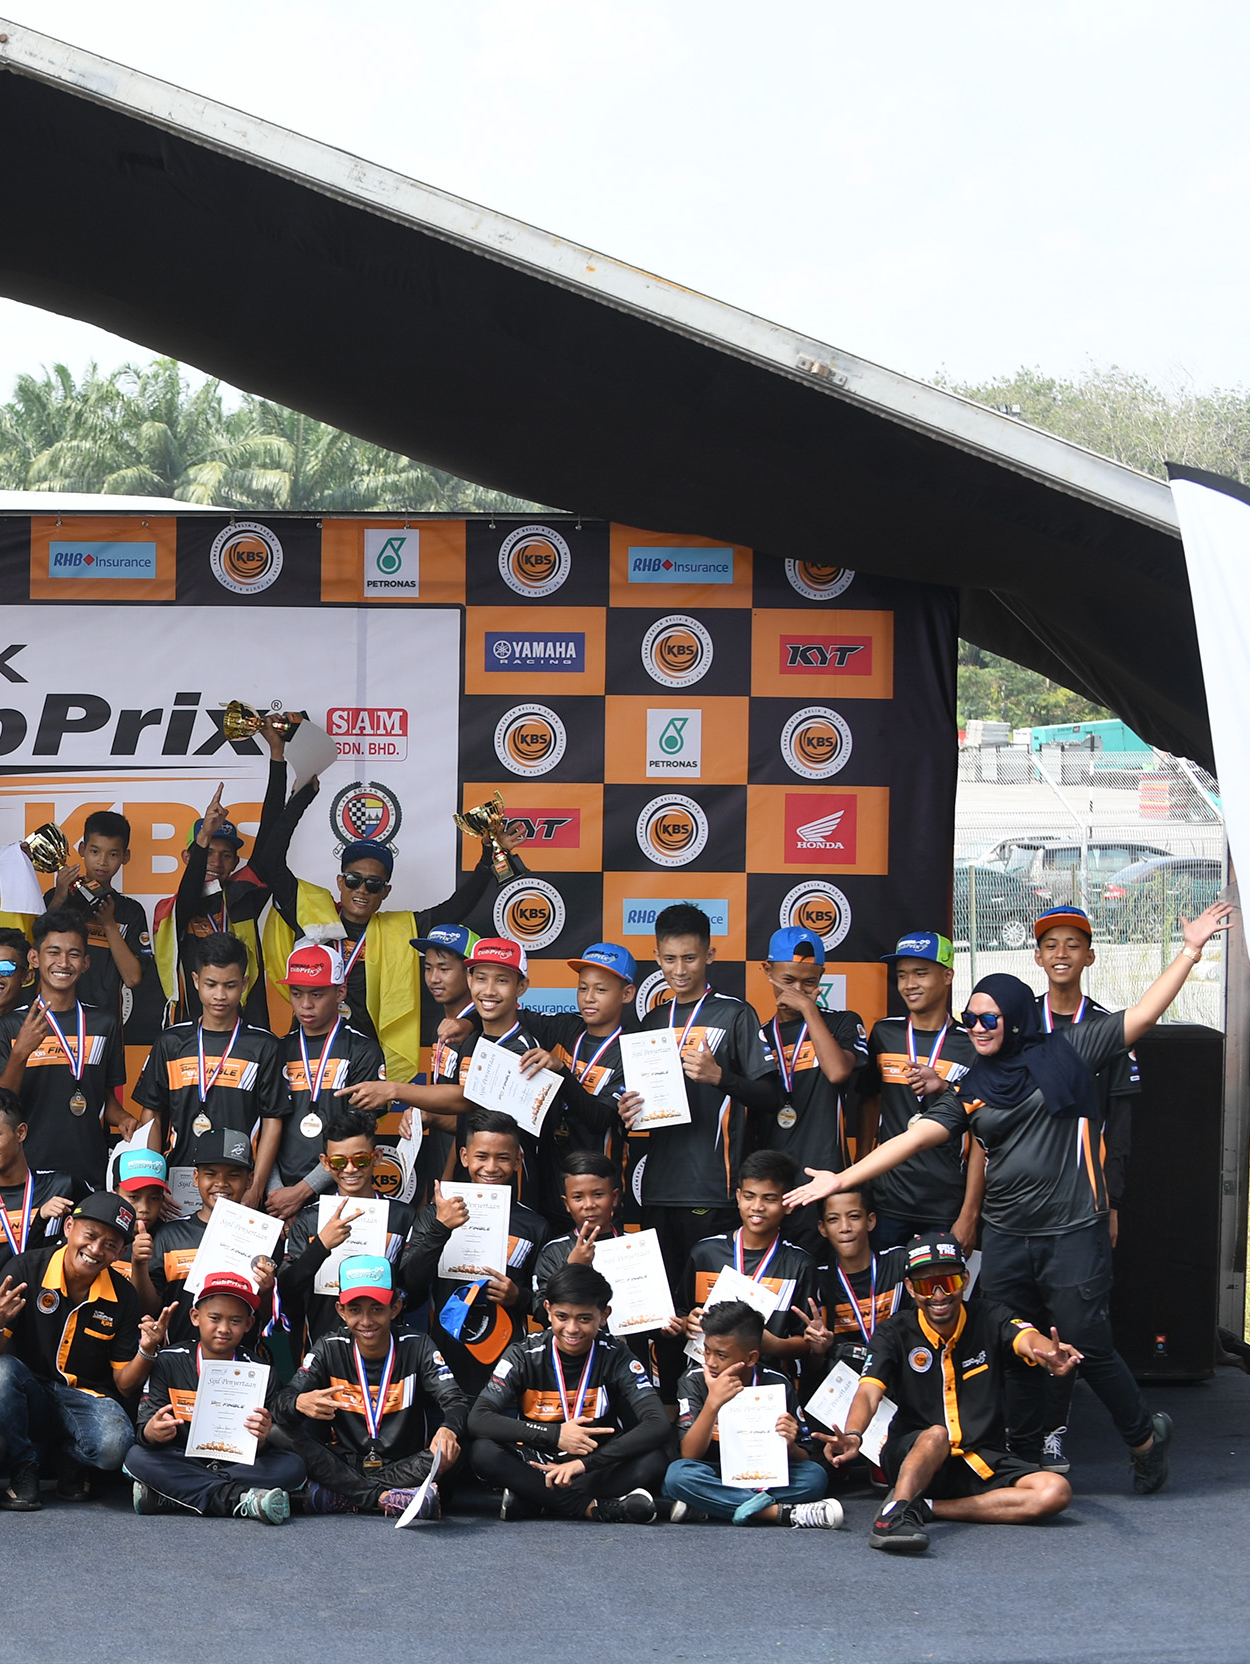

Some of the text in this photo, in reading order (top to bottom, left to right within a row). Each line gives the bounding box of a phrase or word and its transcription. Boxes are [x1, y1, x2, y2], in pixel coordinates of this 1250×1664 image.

[53, 552, 151, 568] RHB Insurance
[236, 551, 263, 563] KBS
[524, 555, 551, 567] KBS
[632, 557, 729, 573] RHB Insurance
[366, 580, 416, 588] PETRONAS
[512, 641, 576, 659] YAMAHA
[667, 645, 694, 657] KBS
[786, 645, 865, 667] KYT
[332, 711, 403, 734] SAM
[520, 734, 547, 746] KBS
[806, 737, 833, 749] KBS
[368, 742, 400, 755] BHD.
[649, 760, 698, 768] PETRONAS
[662, 824, 689, 836] KBS
[796, 841, 845, 849] HONDA
[519, 908, 546, 920] KBS
[627, 909, 656, 924] RHB
[805, 911, 832, 923] KBS
[521, 1001, 577, 1013] Insurance
[370, 1175, 397, 1187] KBS
